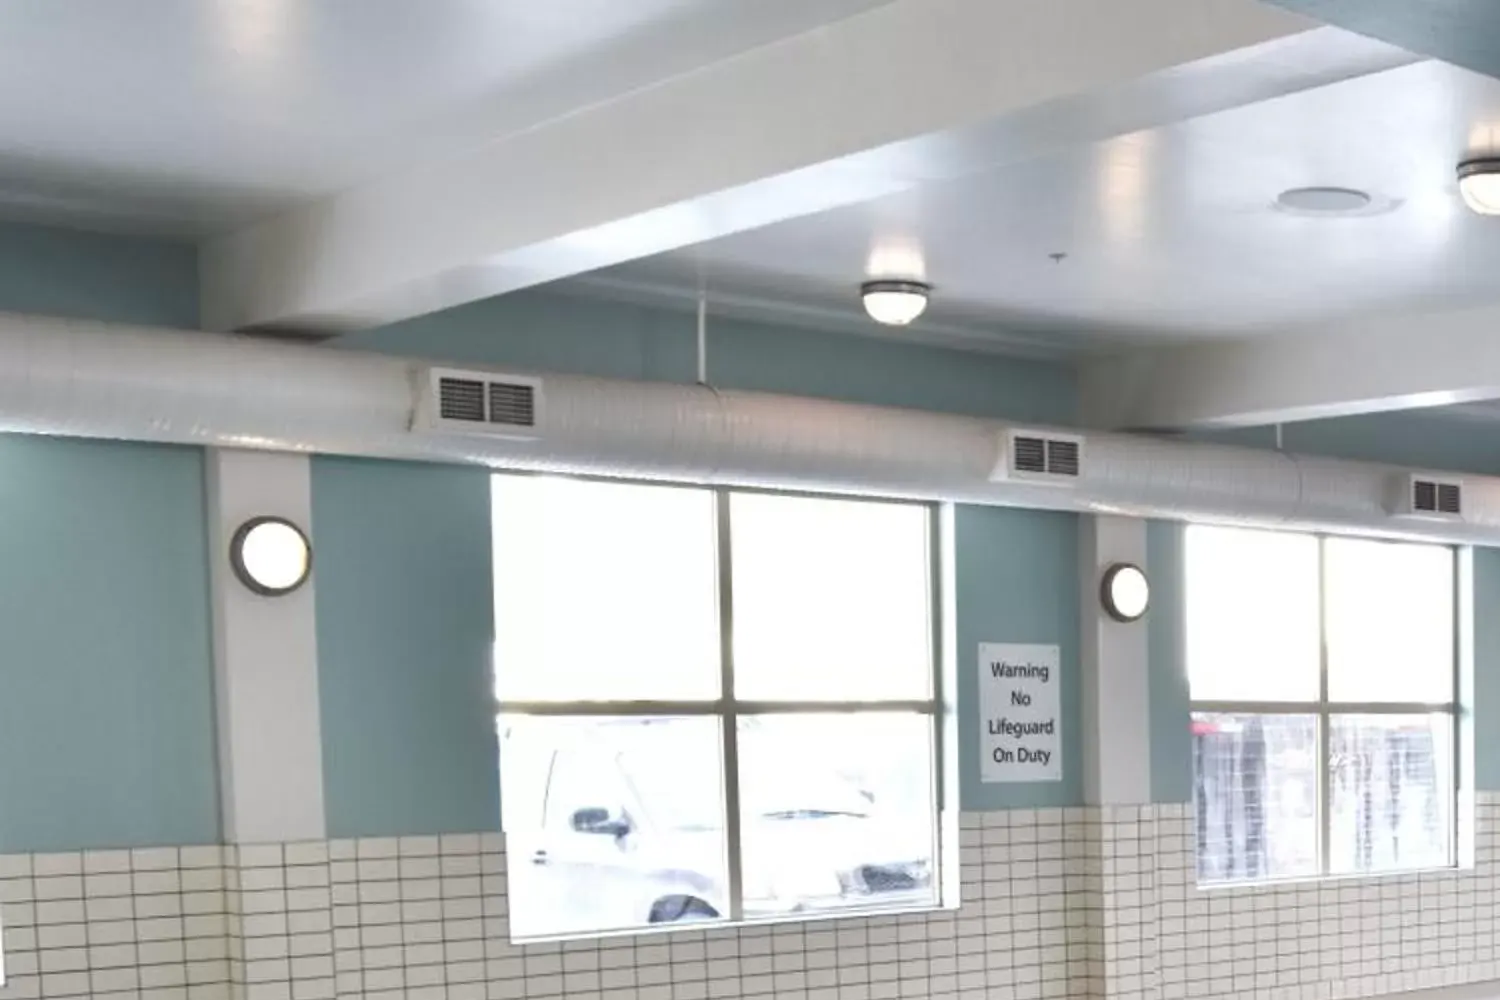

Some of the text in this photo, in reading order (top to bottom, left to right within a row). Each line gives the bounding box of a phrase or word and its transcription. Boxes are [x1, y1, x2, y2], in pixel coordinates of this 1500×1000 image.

[991, 662, 1049, 682] Warning
[1011, 691, 1031, 706] No
[988, 718, 1054, 738] Lifeguard
[993, 747, 1051, 766] On Duty
